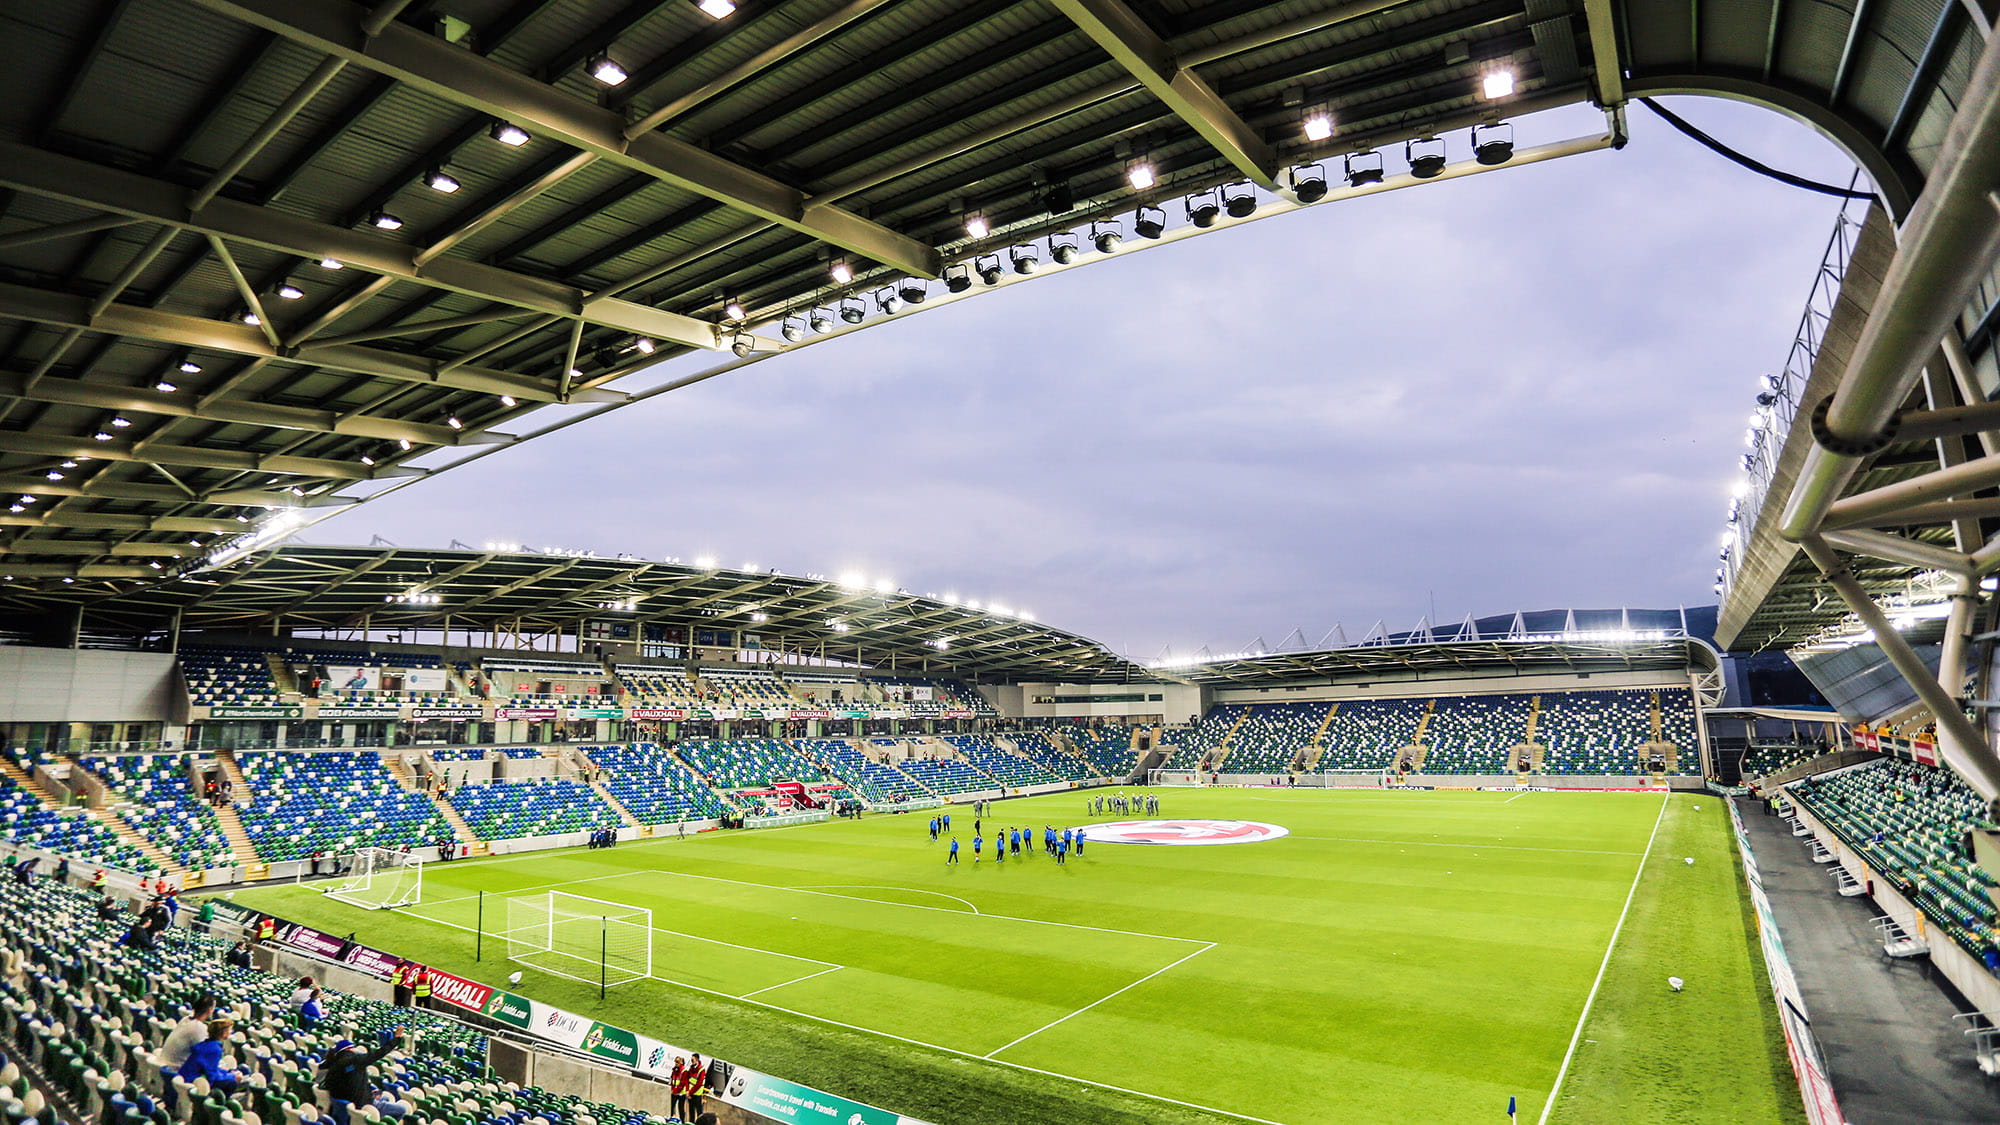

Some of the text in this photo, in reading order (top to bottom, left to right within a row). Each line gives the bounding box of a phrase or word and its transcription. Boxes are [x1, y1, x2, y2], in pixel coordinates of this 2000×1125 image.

[639, 710, 682, 718] VAUXHALL
[429, 970, 487, 1009] AUXHALL
[602, 1037, 633, 1056] irishfa.com
[788, 1093, 803, 1106] travel
[803, 1098, 815, 1110] with
[815, 1101, 839, 1118] Translink
